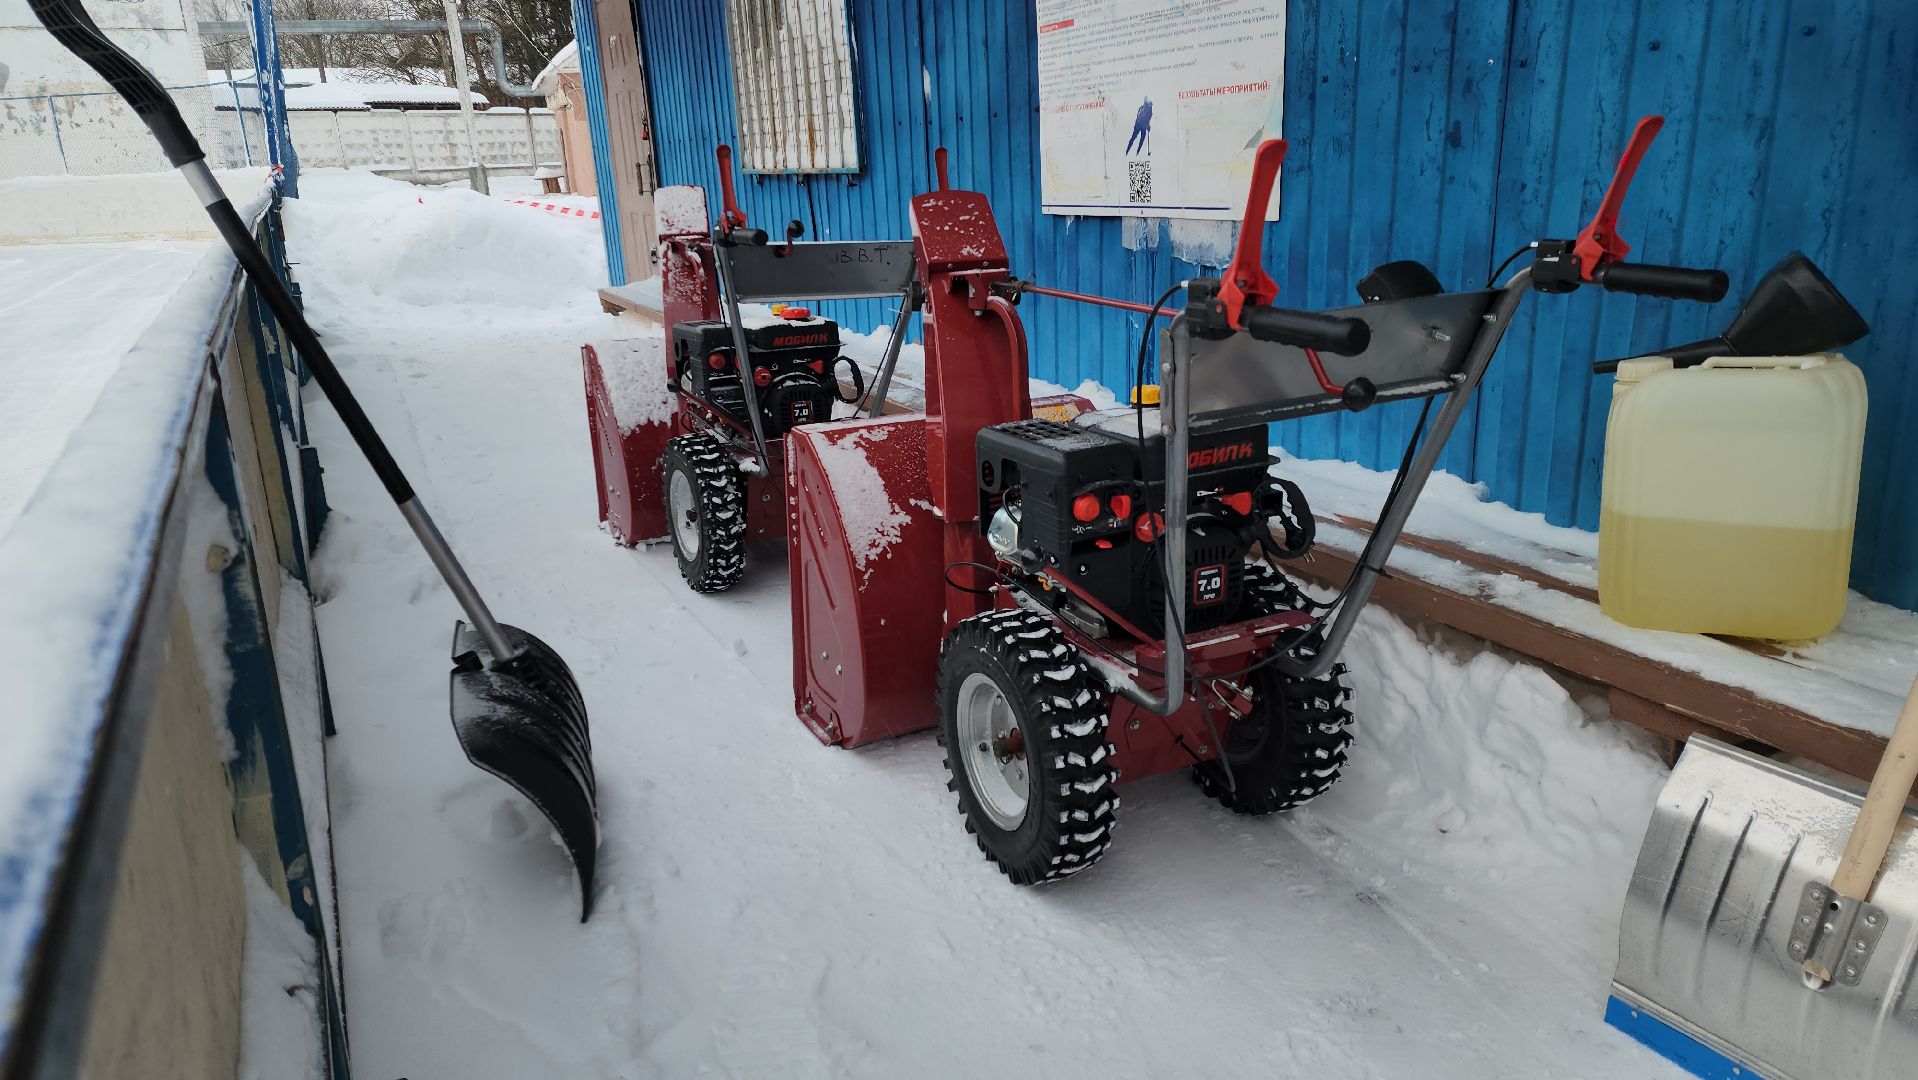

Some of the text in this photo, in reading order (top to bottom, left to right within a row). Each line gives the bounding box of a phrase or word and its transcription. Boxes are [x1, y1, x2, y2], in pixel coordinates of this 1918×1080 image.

[793, 408, 809, 417] 7.0
[1187, 442, 1254, 469] ОБИЛК
[1197, 576, 1221, 592] 7.0
